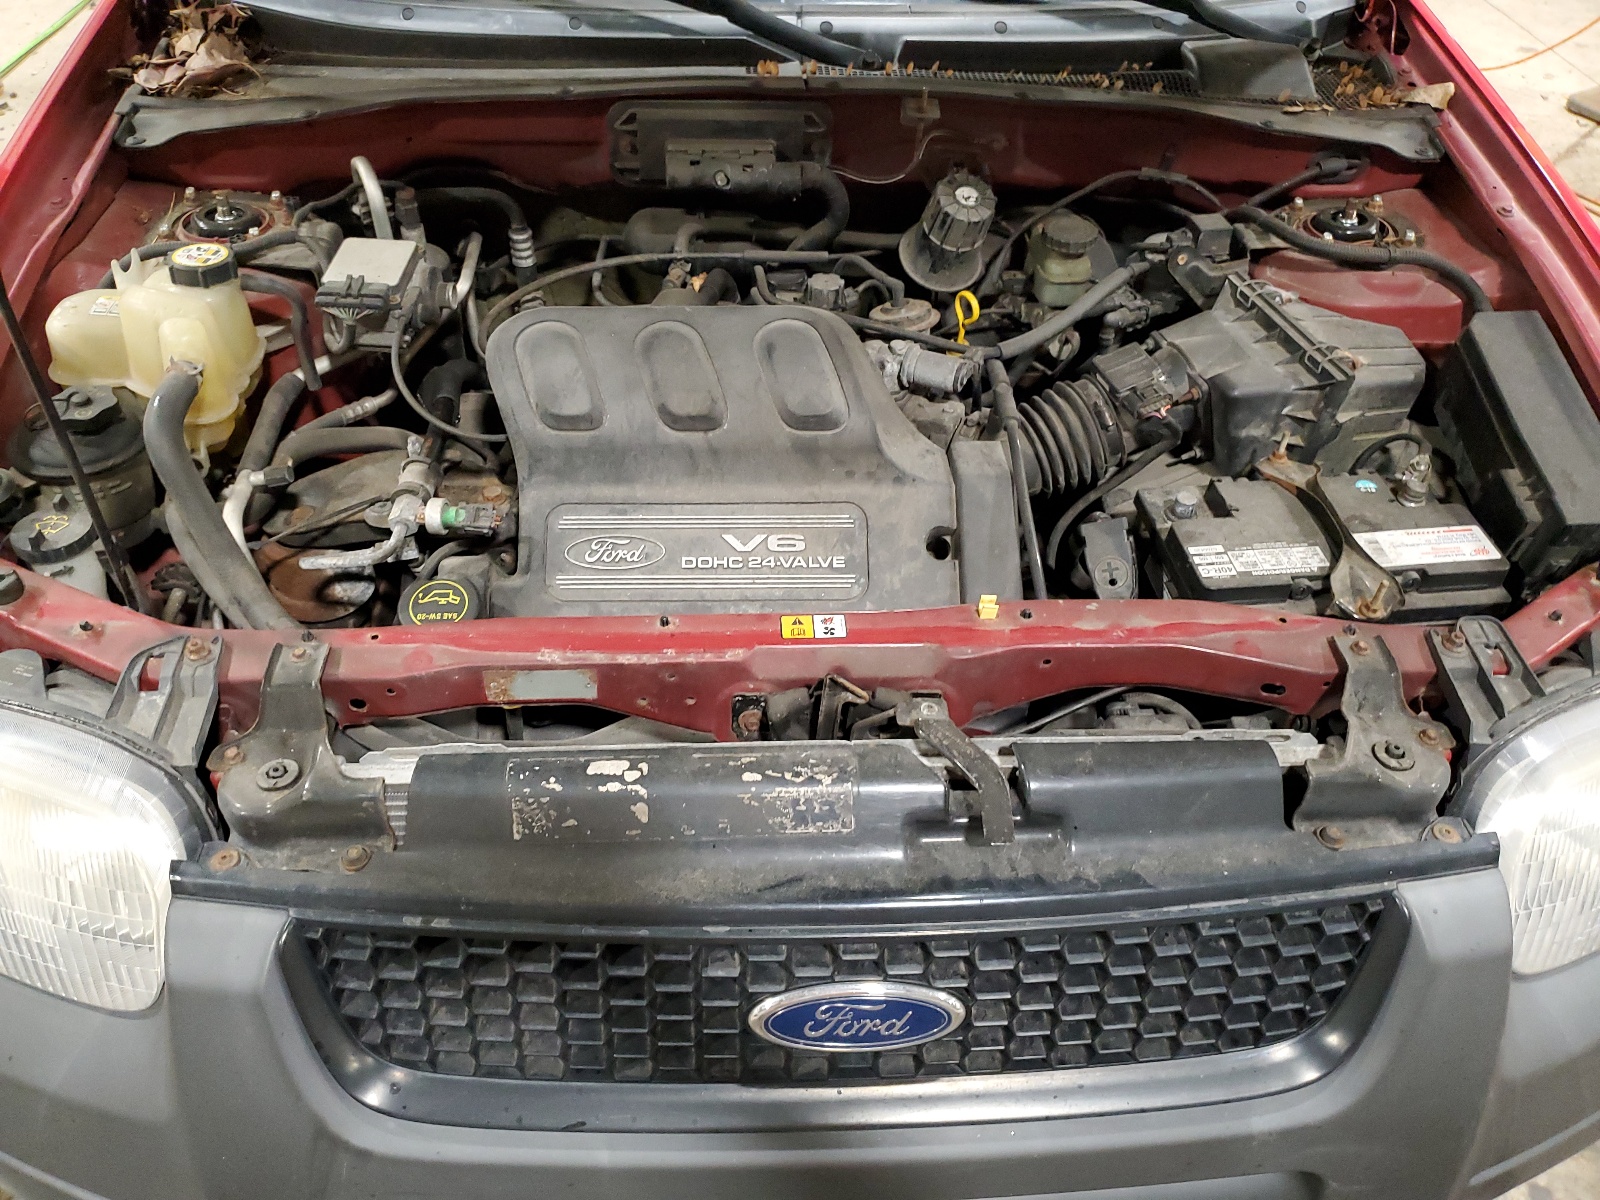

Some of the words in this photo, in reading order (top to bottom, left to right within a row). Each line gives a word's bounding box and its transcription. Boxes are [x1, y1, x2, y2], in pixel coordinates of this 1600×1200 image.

[721, 533, 806, 553] V6
[584, 538, 645, 563] Ford
[681, 556, 744, 570] DOHC
[1201, 565, 1233, 575] 40R-C
[416, 612, 441, 620] 5W-20
[443, 612, 458, 620] SAE
[803, 1003, 912, 1037] Ford
